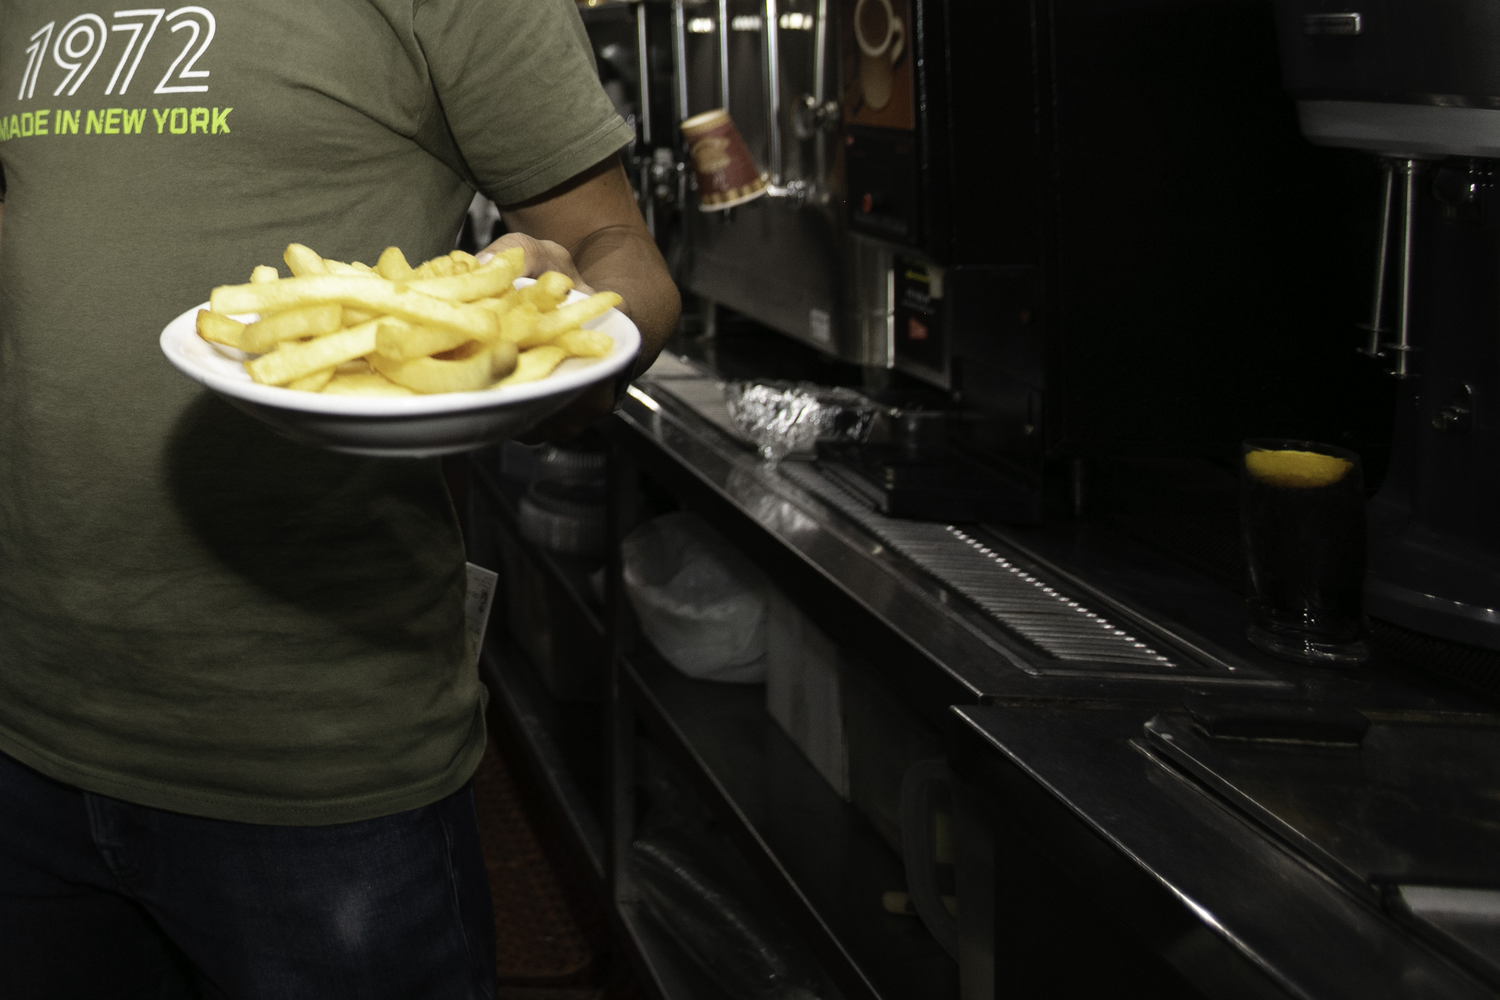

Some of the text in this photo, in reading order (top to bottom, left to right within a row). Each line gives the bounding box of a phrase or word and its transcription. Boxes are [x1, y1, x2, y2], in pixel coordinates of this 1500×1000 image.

[17, 5, 217, 101] 1972
[54, 109, 81, 135] IN
[84, 108, 148, 135] NEW
[151, 106, 234, 135] YORK
